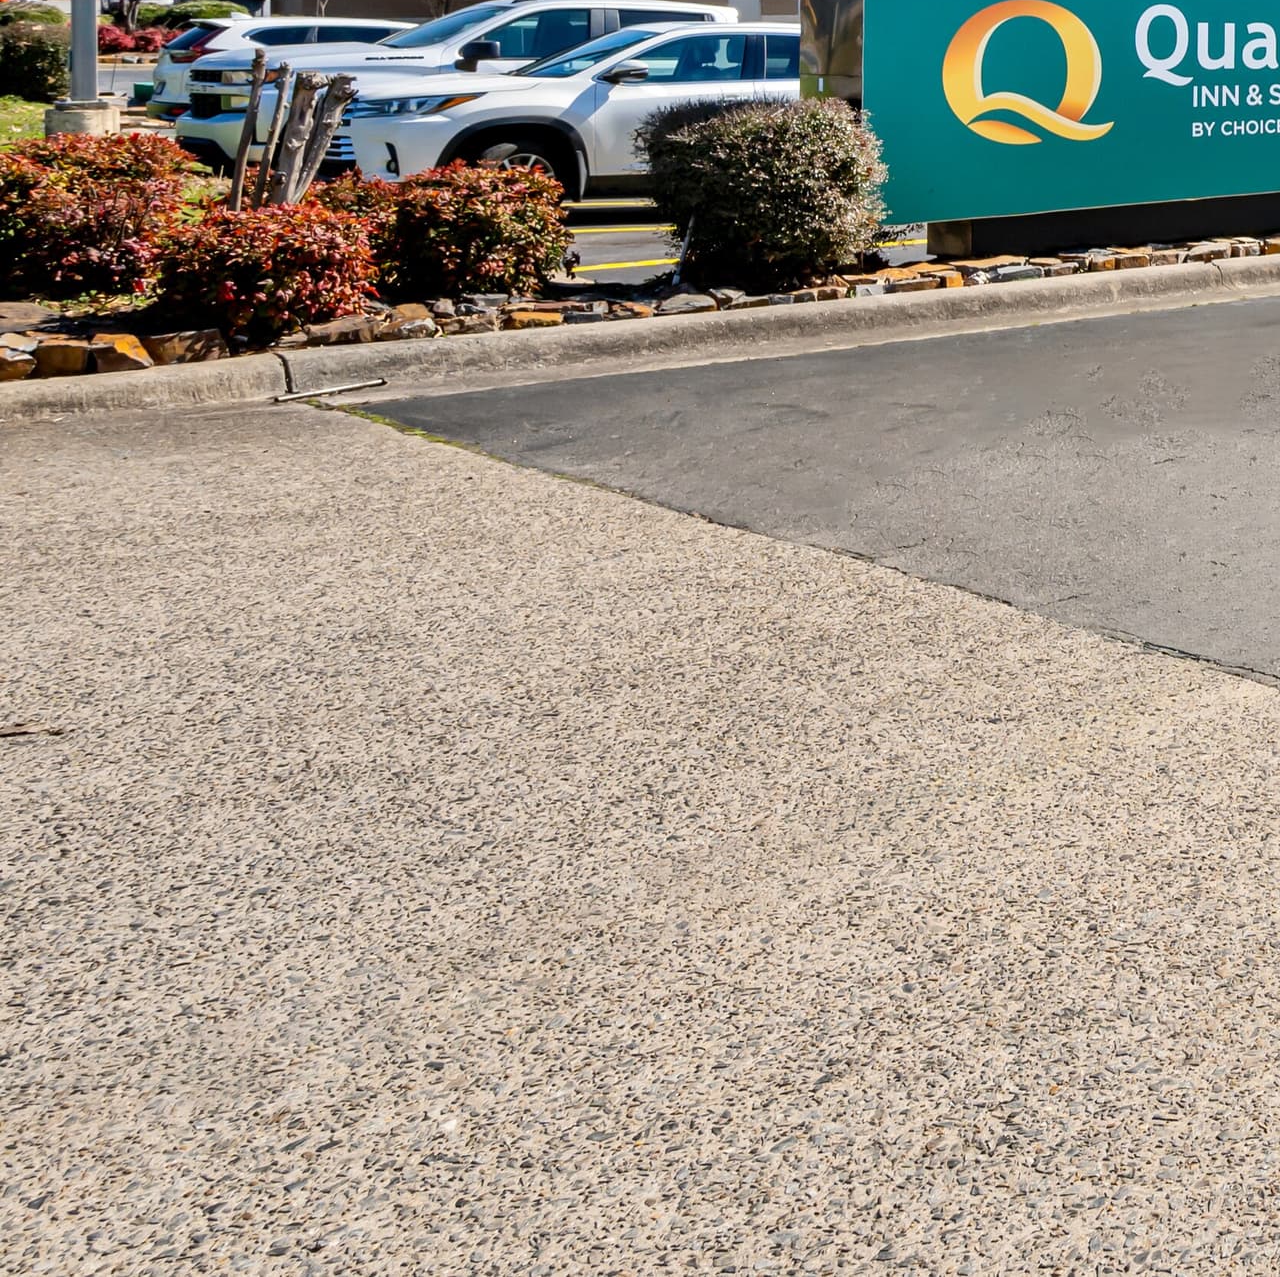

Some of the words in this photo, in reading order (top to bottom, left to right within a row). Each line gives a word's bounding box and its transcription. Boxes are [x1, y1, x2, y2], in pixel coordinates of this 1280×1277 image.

[1192, 85, 1240, 108] INN
[1246, 84, 1263, 106] &
[1191, 121, 1215, 138] BY
